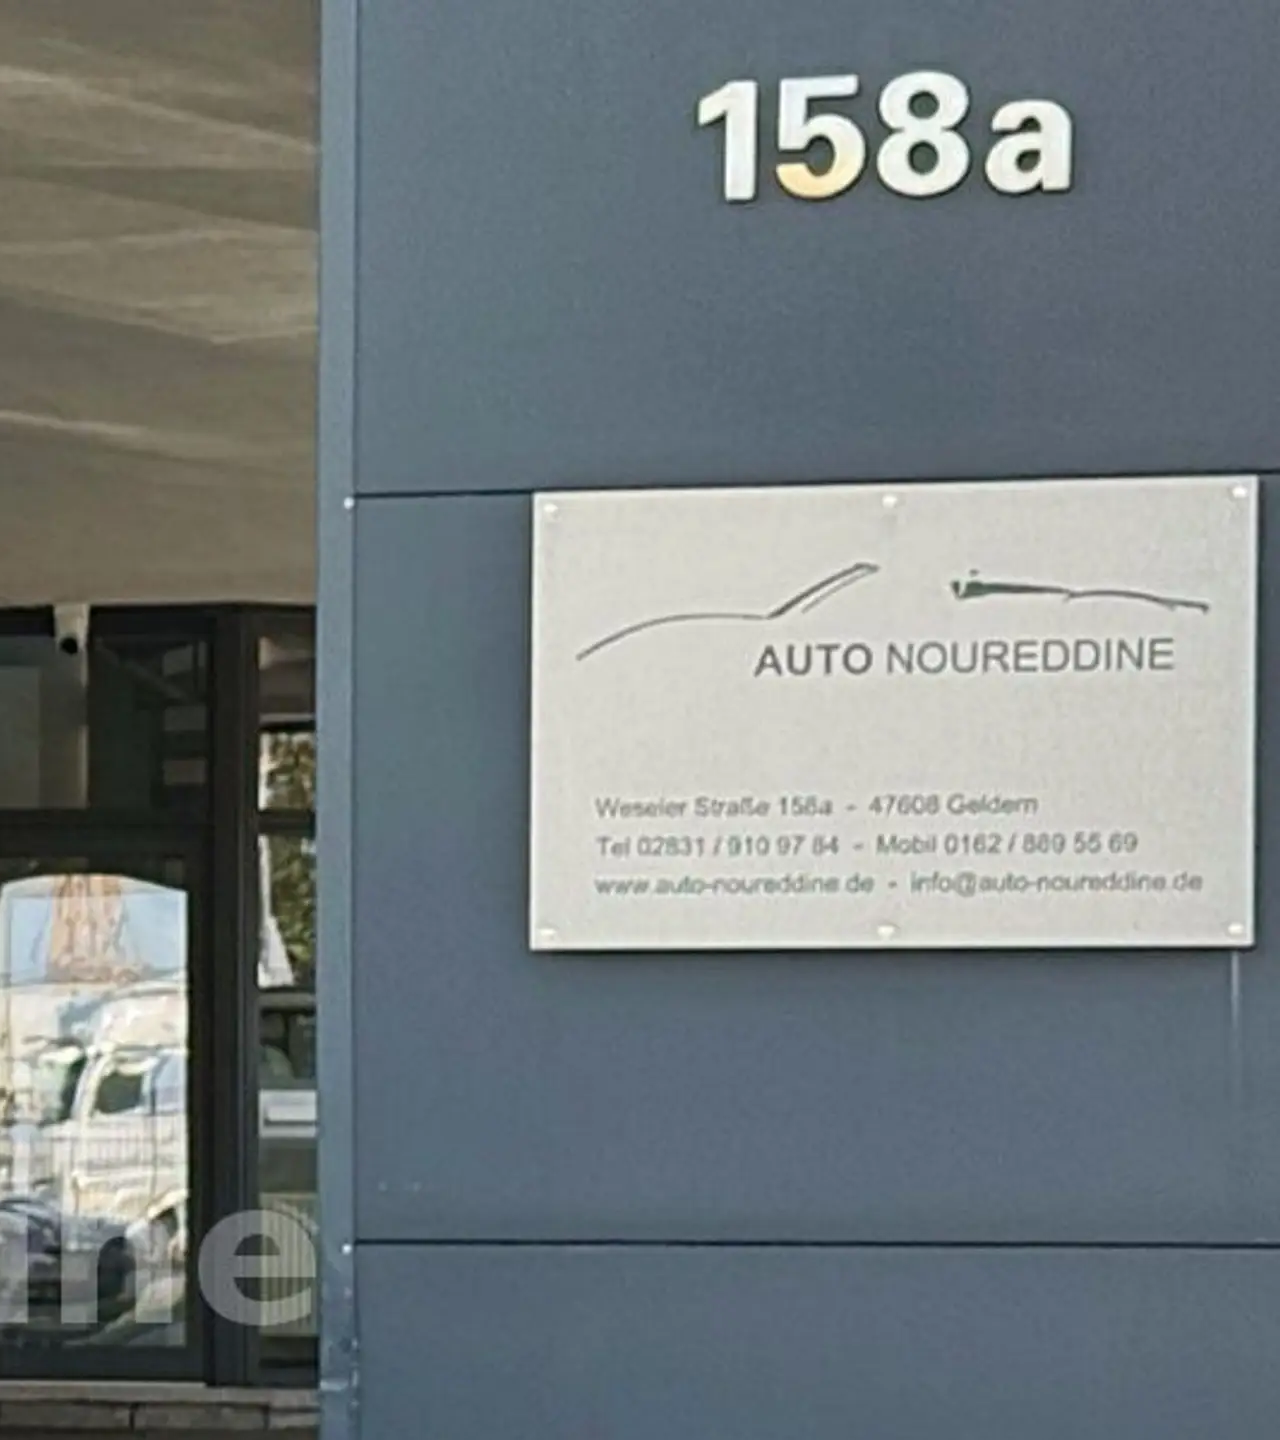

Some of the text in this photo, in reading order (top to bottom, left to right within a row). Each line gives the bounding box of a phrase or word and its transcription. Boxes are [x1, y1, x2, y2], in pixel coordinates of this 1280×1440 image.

[698, 70, 1072, 201] 158a
[754, 637, 1175, 677] AUTO NOUREDDINE
[693, 796, 770, 817] Straße
[778, 796, 833, 816] 158a
[868, 794, 939, 816] 47608
[946, 793, 1039, 815] Geldern
[595, 836, 631, 857] Tel
[636, 835, 705, 857] 02831
[727, 835, 770, 856] 910
[775, 834, 806, 856] 97
[812, 834, 840, 855] 84
[875, 834, 936, 855] Mobil
[943, 833, 1003, 855] 0162
[1073, 831, 1102, 853] 55
[1107, 831, 1139, 853] 69
[593, 872, 875, 895] www.auto-noureddine.de
[910, 871, 1204, 898] info@auto-noureddine.de
